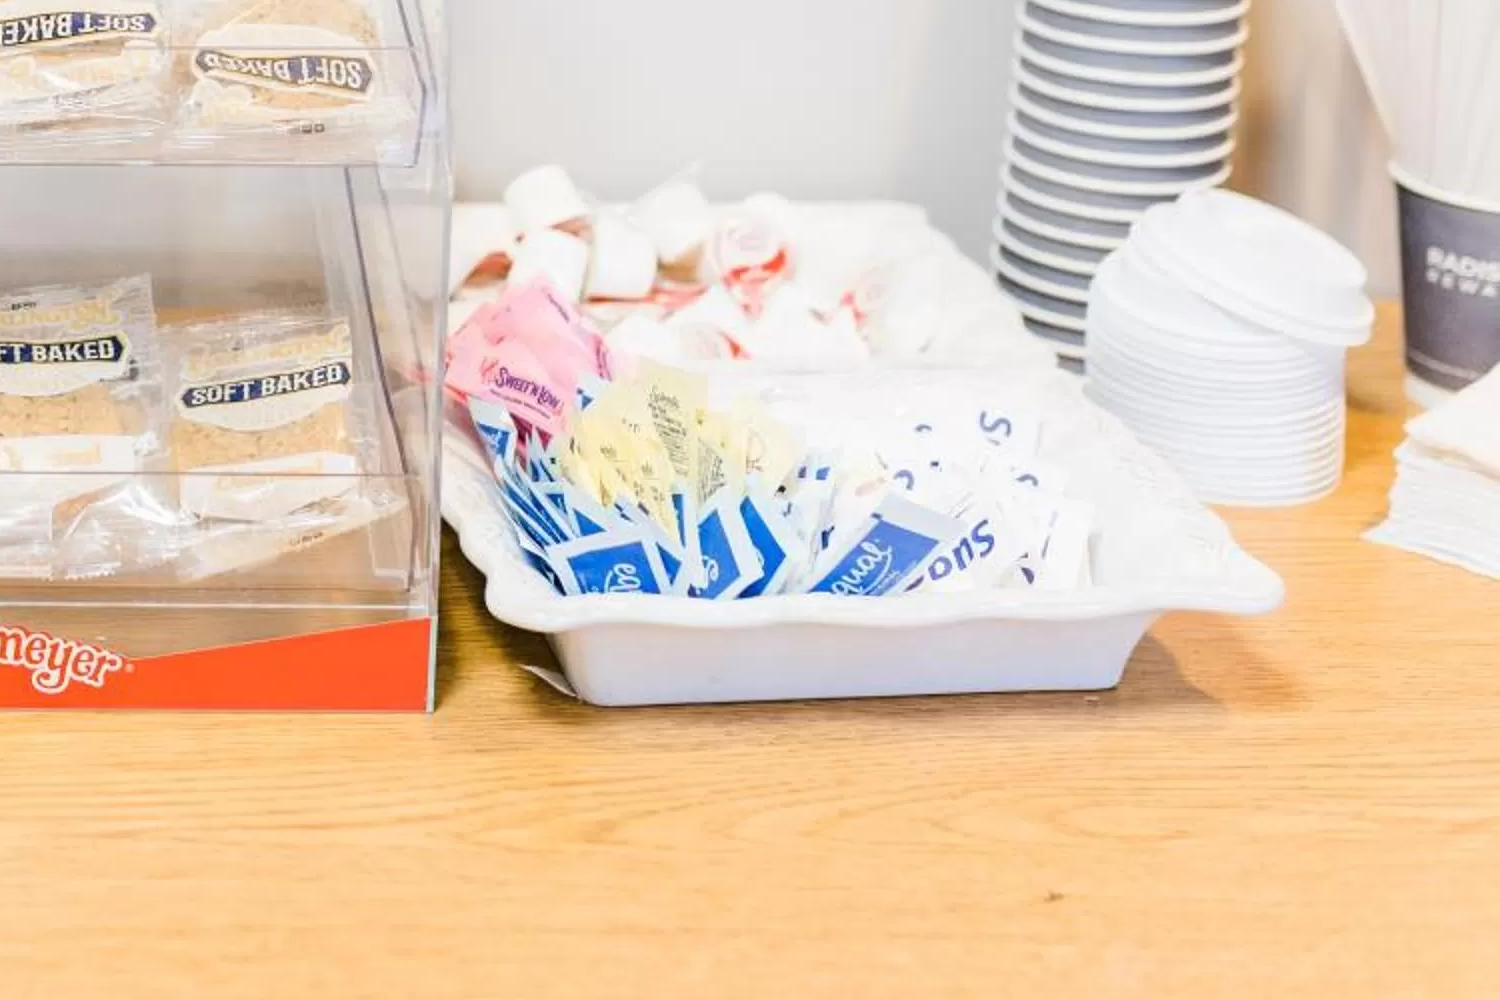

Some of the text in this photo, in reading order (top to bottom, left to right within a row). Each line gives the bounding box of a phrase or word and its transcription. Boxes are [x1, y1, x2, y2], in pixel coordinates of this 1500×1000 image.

[78, 12, 146, 33] SOFT
[203, 53, 363, 89] SOFT BAKED
[32, 339, 115, 362] BAKED
[191, 363, 343, 405] SOFT BAKED
